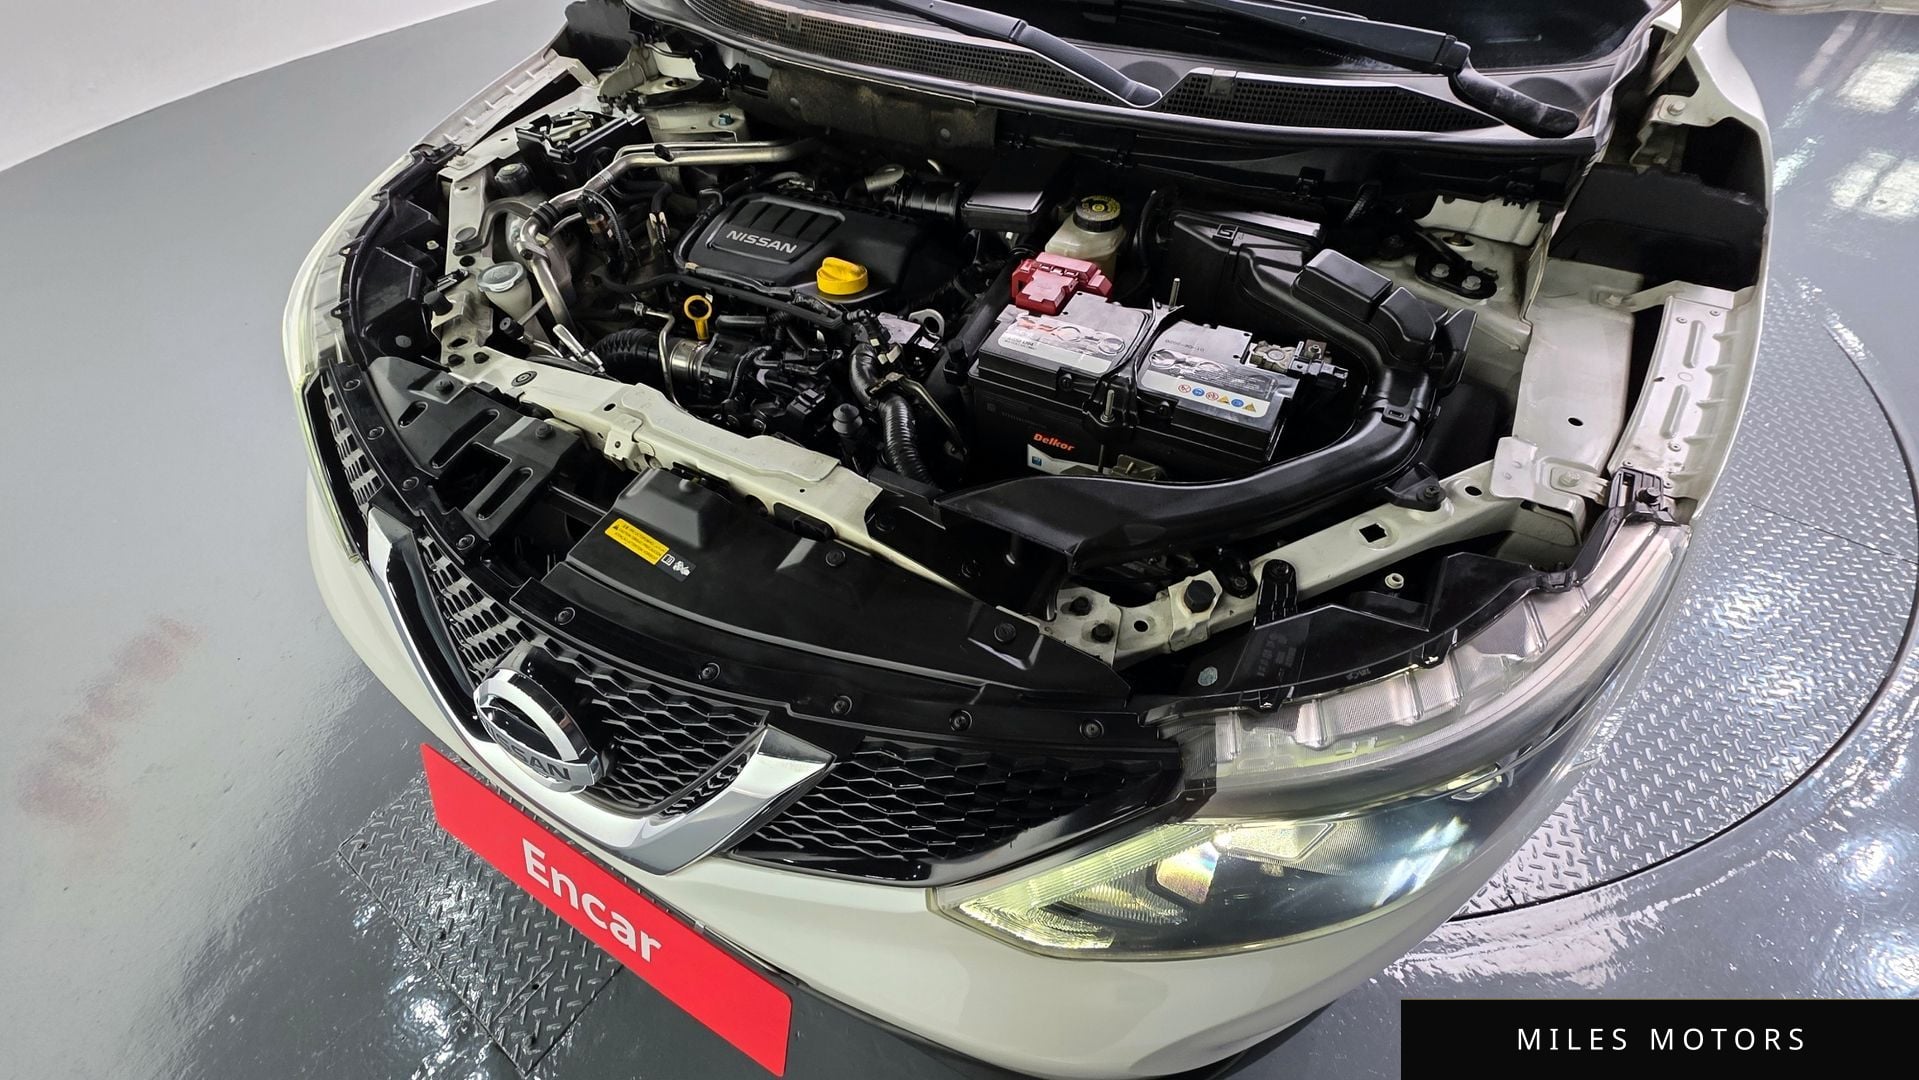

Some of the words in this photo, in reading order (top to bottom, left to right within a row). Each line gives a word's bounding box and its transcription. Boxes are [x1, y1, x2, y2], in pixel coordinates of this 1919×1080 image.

[726, 229, 798, 254] NISSAN
[1033, 432, 1075, 452] Delkor
[522, 837, 662, 963] Encar
